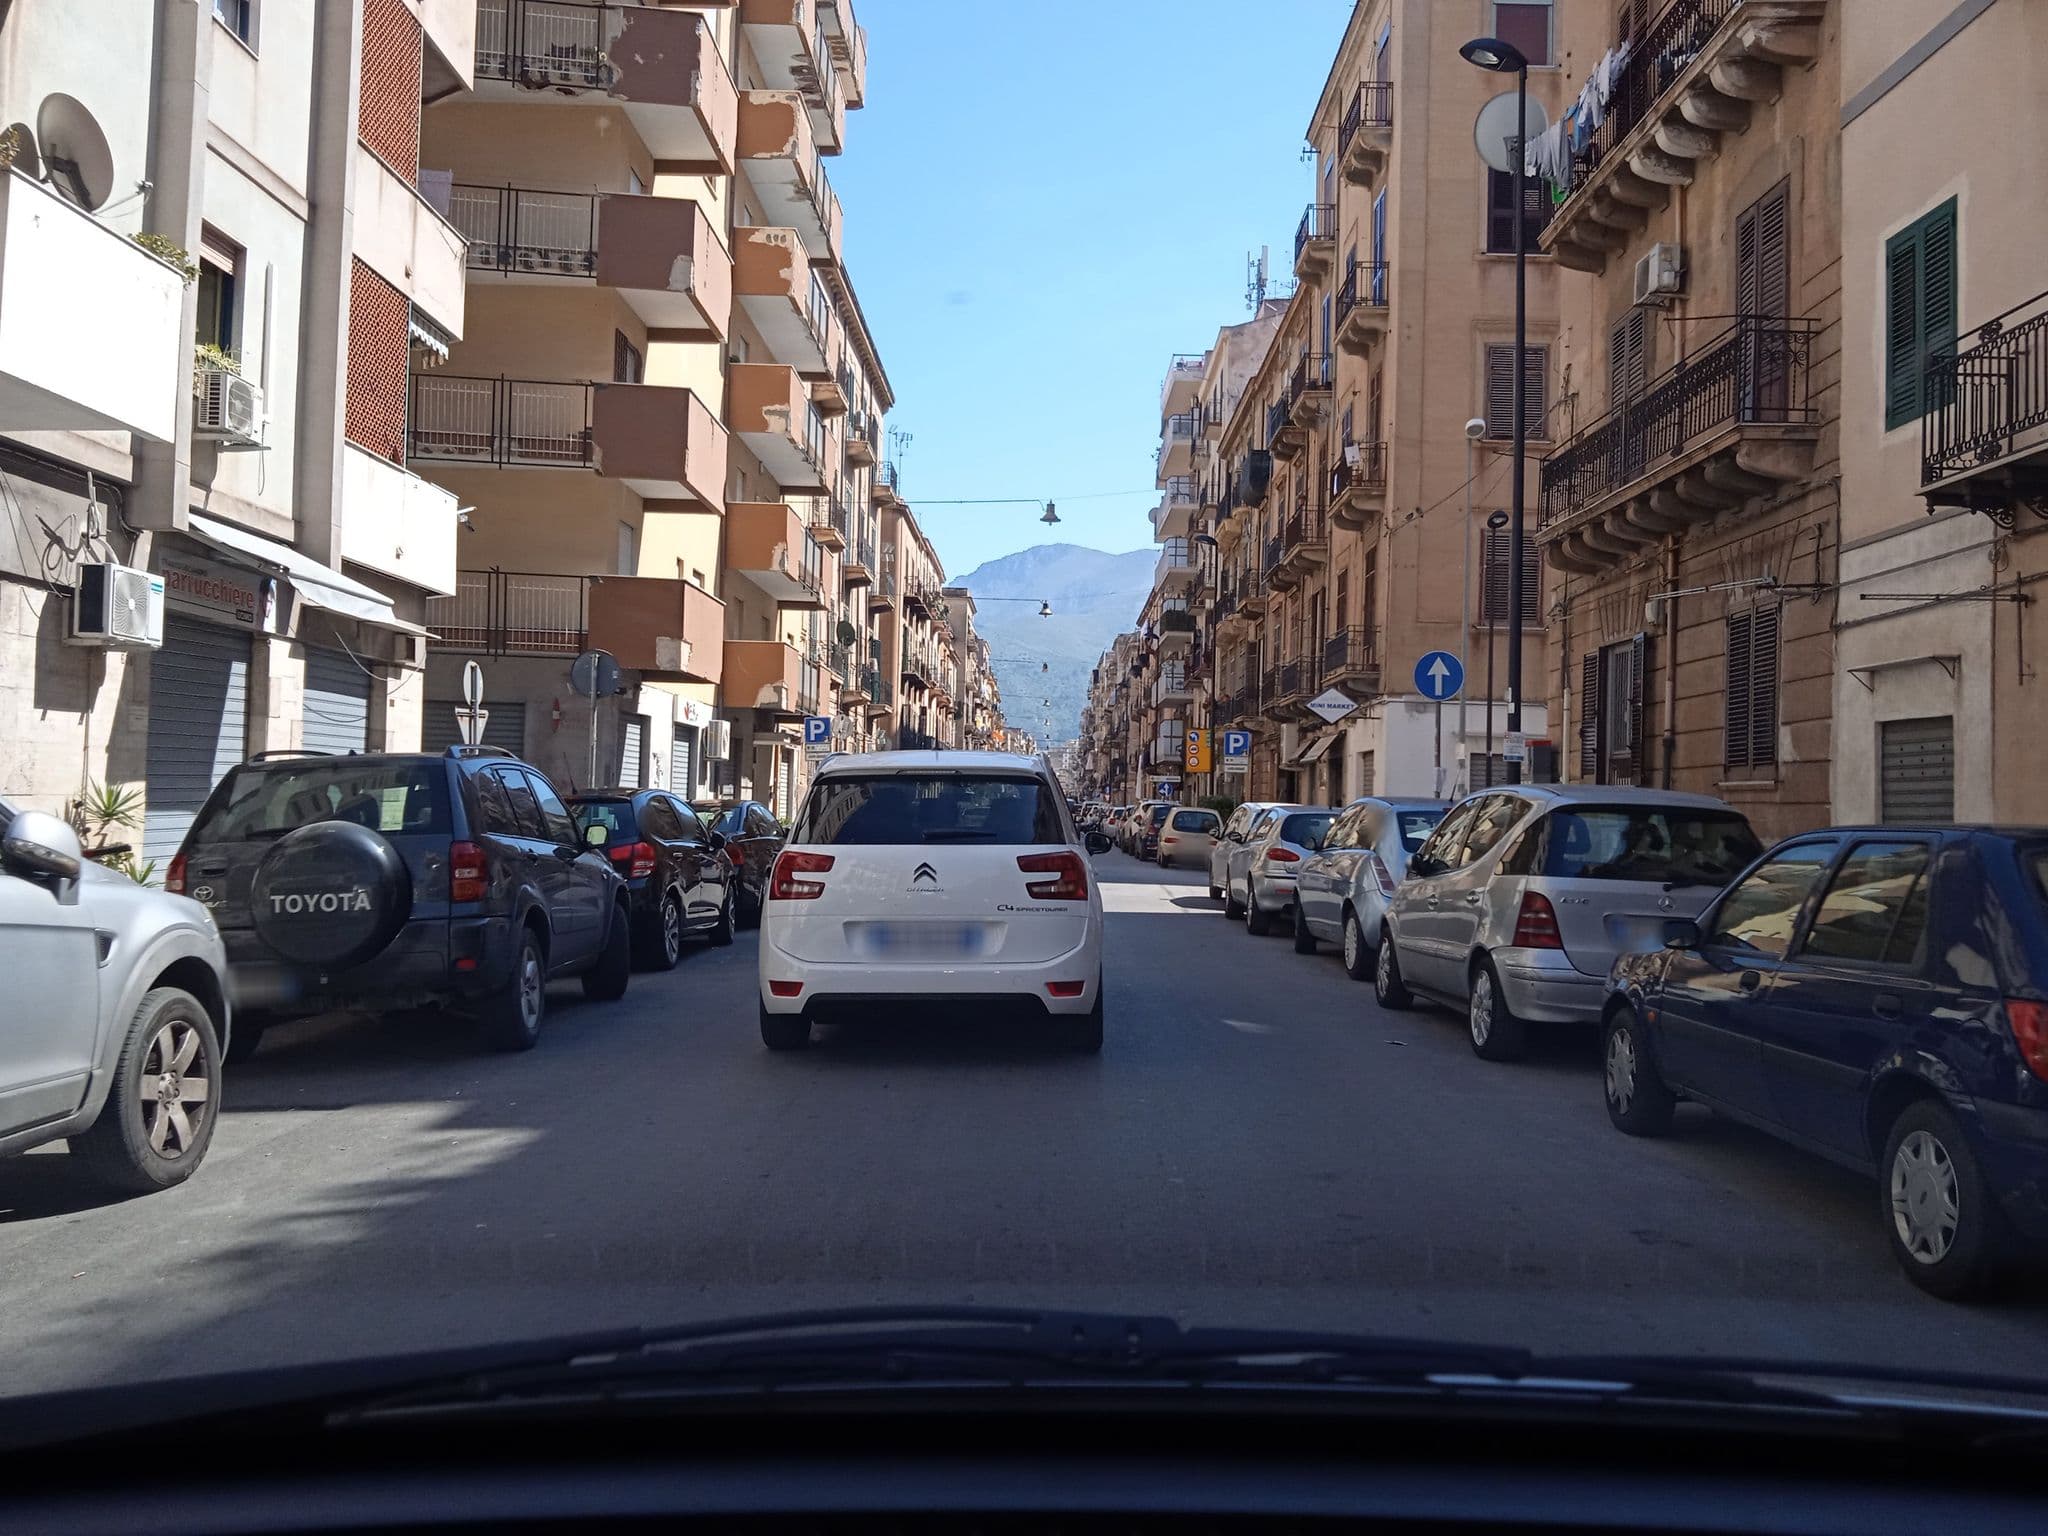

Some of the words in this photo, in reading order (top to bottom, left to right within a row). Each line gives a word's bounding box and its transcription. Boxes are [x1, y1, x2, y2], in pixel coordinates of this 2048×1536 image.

[809, 720, 825, 741] P
[1229, 734, 1244, 754] P
[270, 893, 371, 913] TOYOTA
